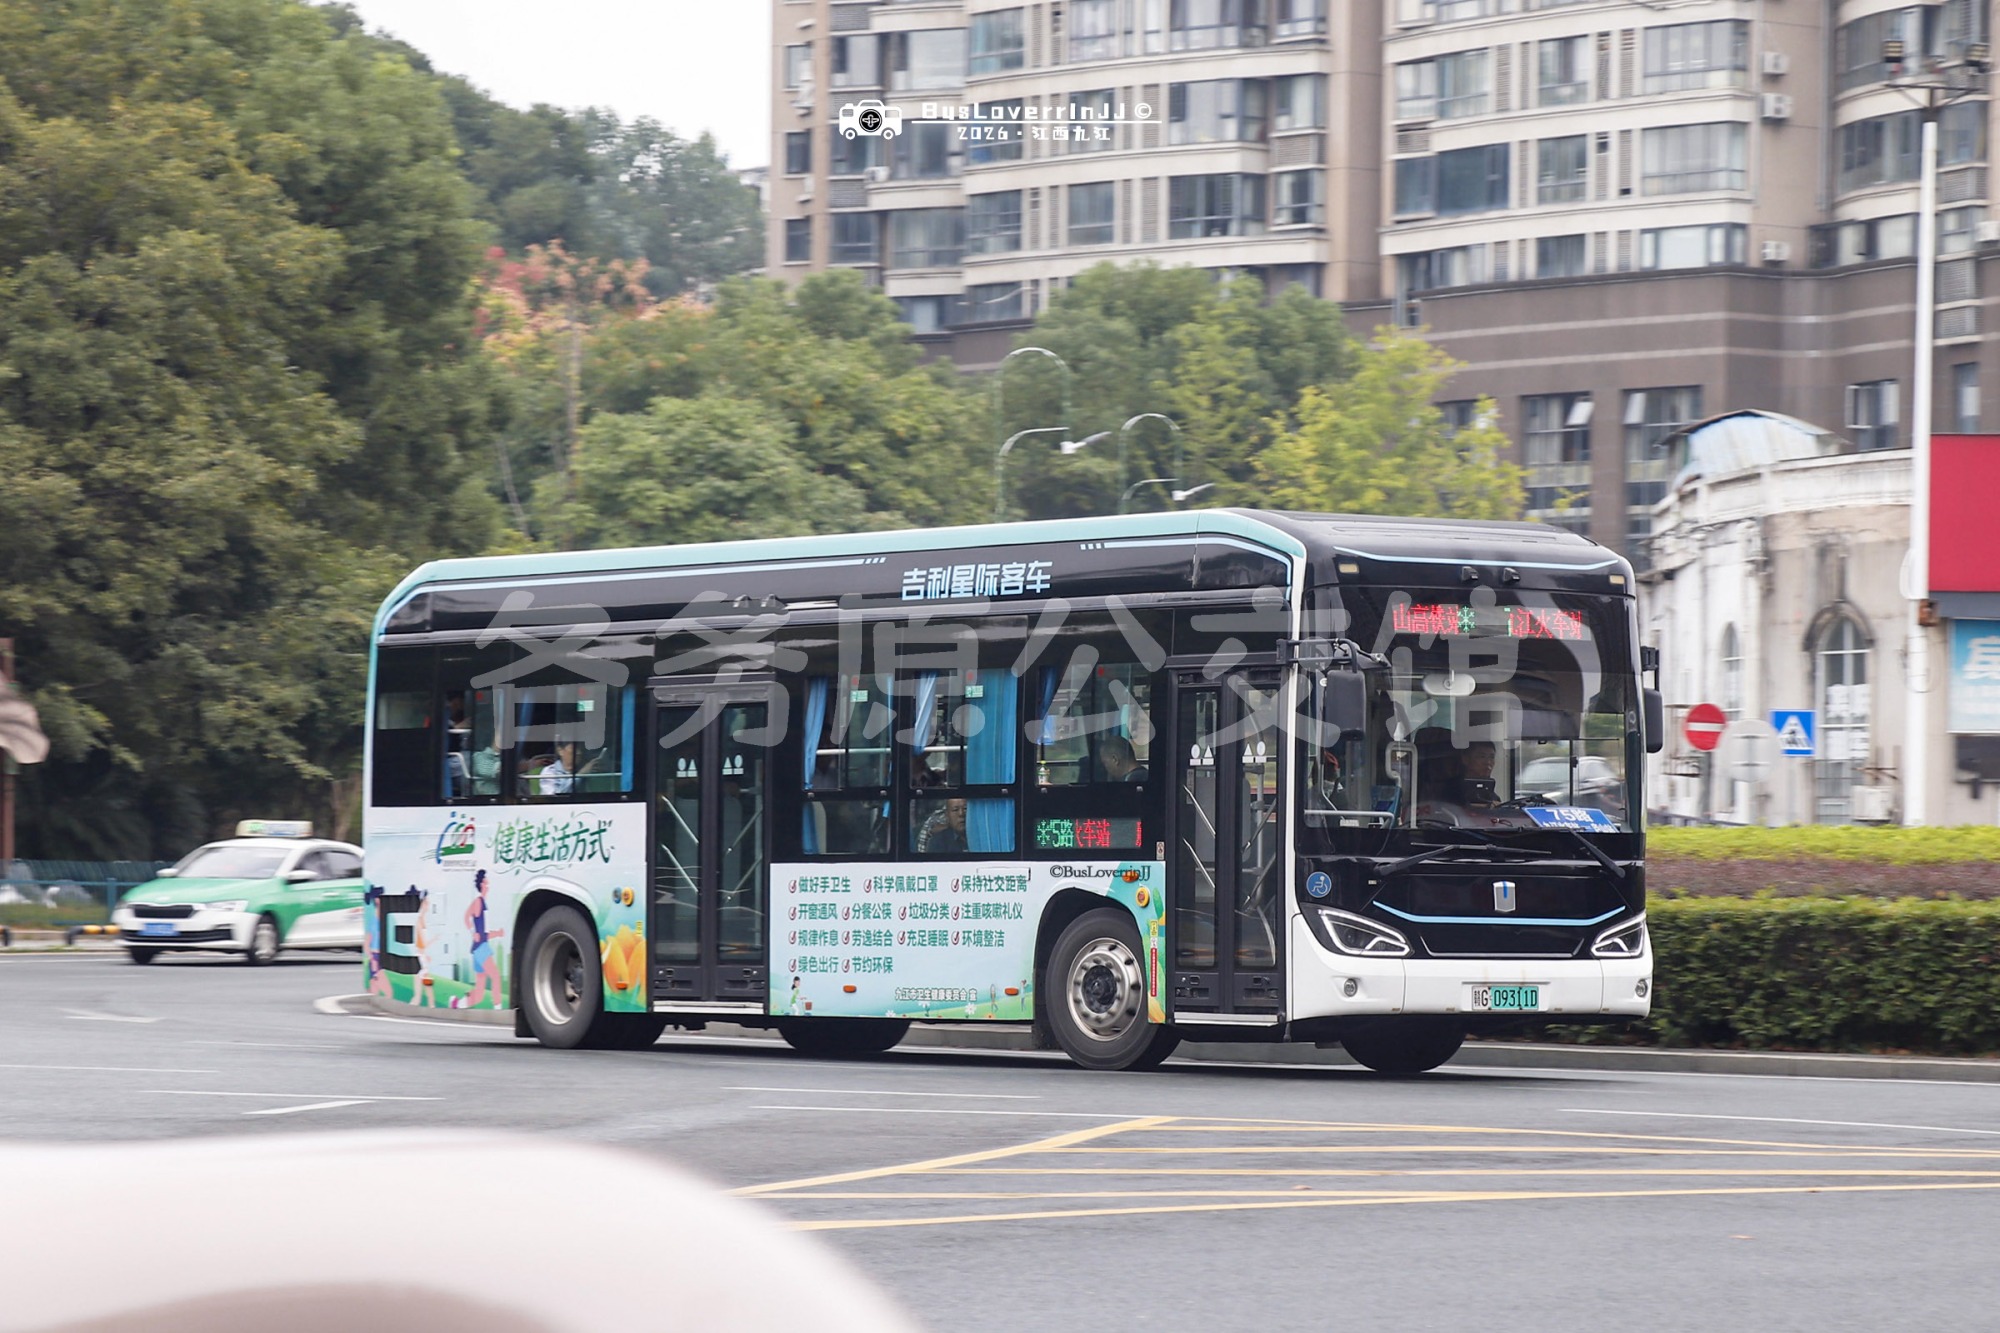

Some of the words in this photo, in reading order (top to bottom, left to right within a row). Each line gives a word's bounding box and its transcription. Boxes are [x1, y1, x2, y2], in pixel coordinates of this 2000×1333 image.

[902, 560, 1053, 600] 吉利星际客车
[1545, 808, 1594, 823] 75路
[491, 819, 613, 865] 健康生活方式
[798, 876, 851, 893] 做好手卫生
[873, 875, 938, 893] 科学佩戴口罩
[961, 874, 1027, 893] 保持社交距离
[798, 903, 838, 920] 开窗通风
[851, 902, 892, 920] 分餐公筷
[908, 902, 950, 920] 垃圾分类
[961, 902, 1023, 920] 注重咳嗽礼仪
[798, 929, 839, 947] 规律作息
[851, 929, 893, 947] 劳逸结合
[907, 929, 949, 947] 充足睡眠
[961, 929, 1005, 947] 环境整洁
[798, 955, 839, 973] 绿色出行
[851, 956, 893, 974] 节约环保
